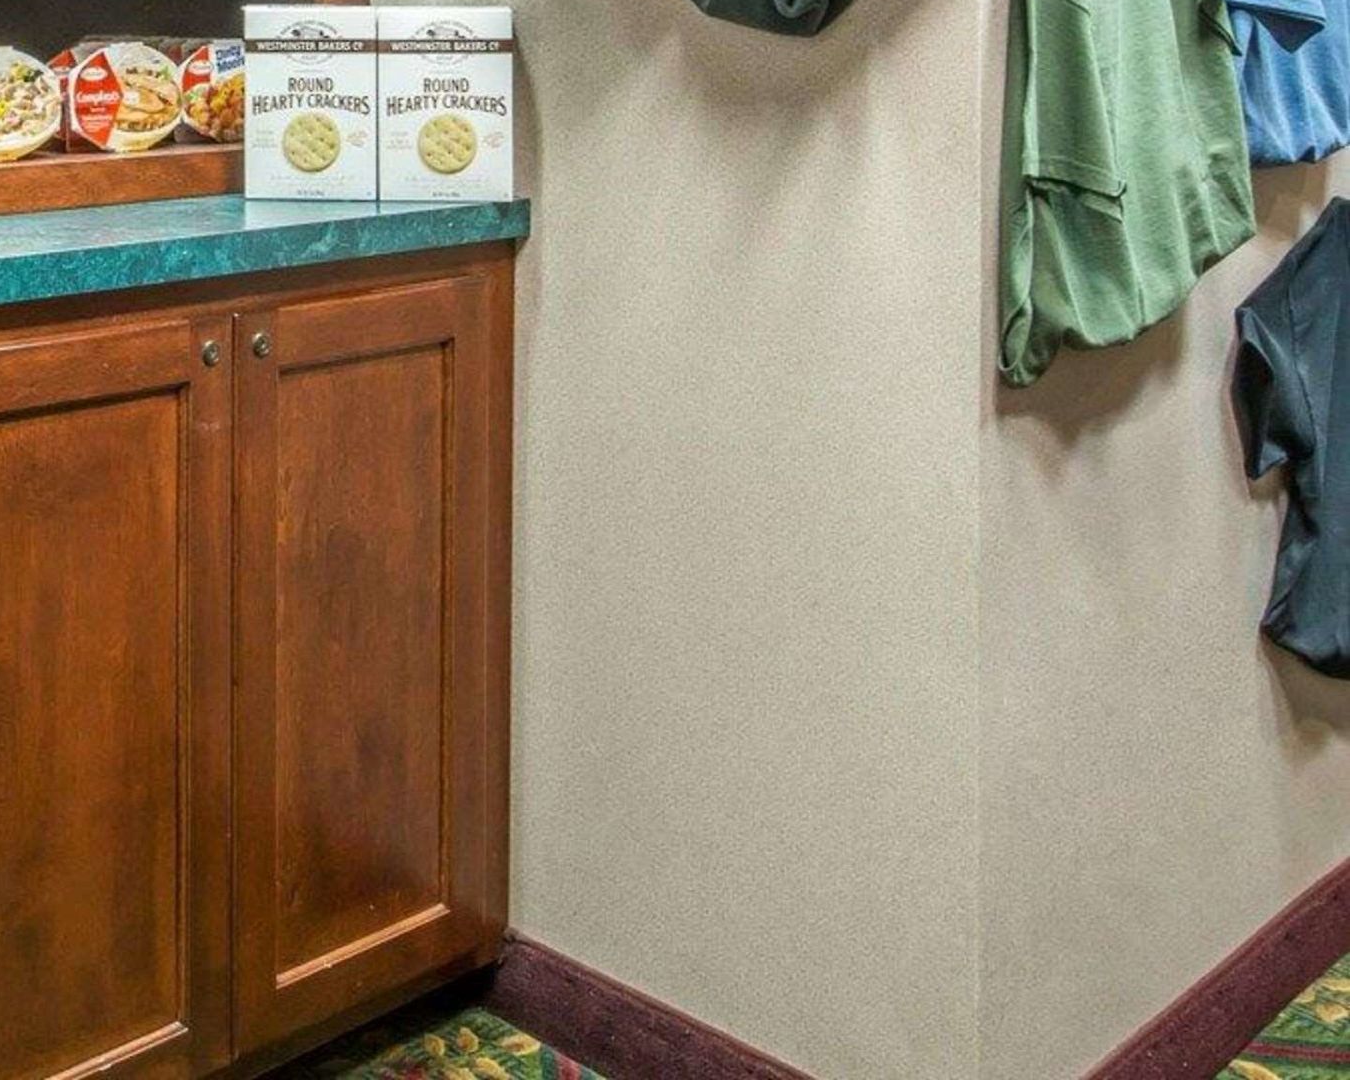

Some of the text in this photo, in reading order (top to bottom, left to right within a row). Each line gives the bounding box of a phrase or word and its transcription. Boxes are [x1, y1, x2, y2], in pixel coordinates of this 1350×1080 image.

[257, 41, 315, 51] WESTMINSTER
[317, 41, 351, 51] BAKERS
[390, 41, 452, 51] WESTMINSTER
[453, 41, 488, 51] BAKERS
[288, 77, 334, 93] ROUND
[423, 77, 470, 93] ROUND
[252, 94, 371, 116] HEARTY CRACKERS
[386, 94, 508, 117] HEARTY CRACKERS
